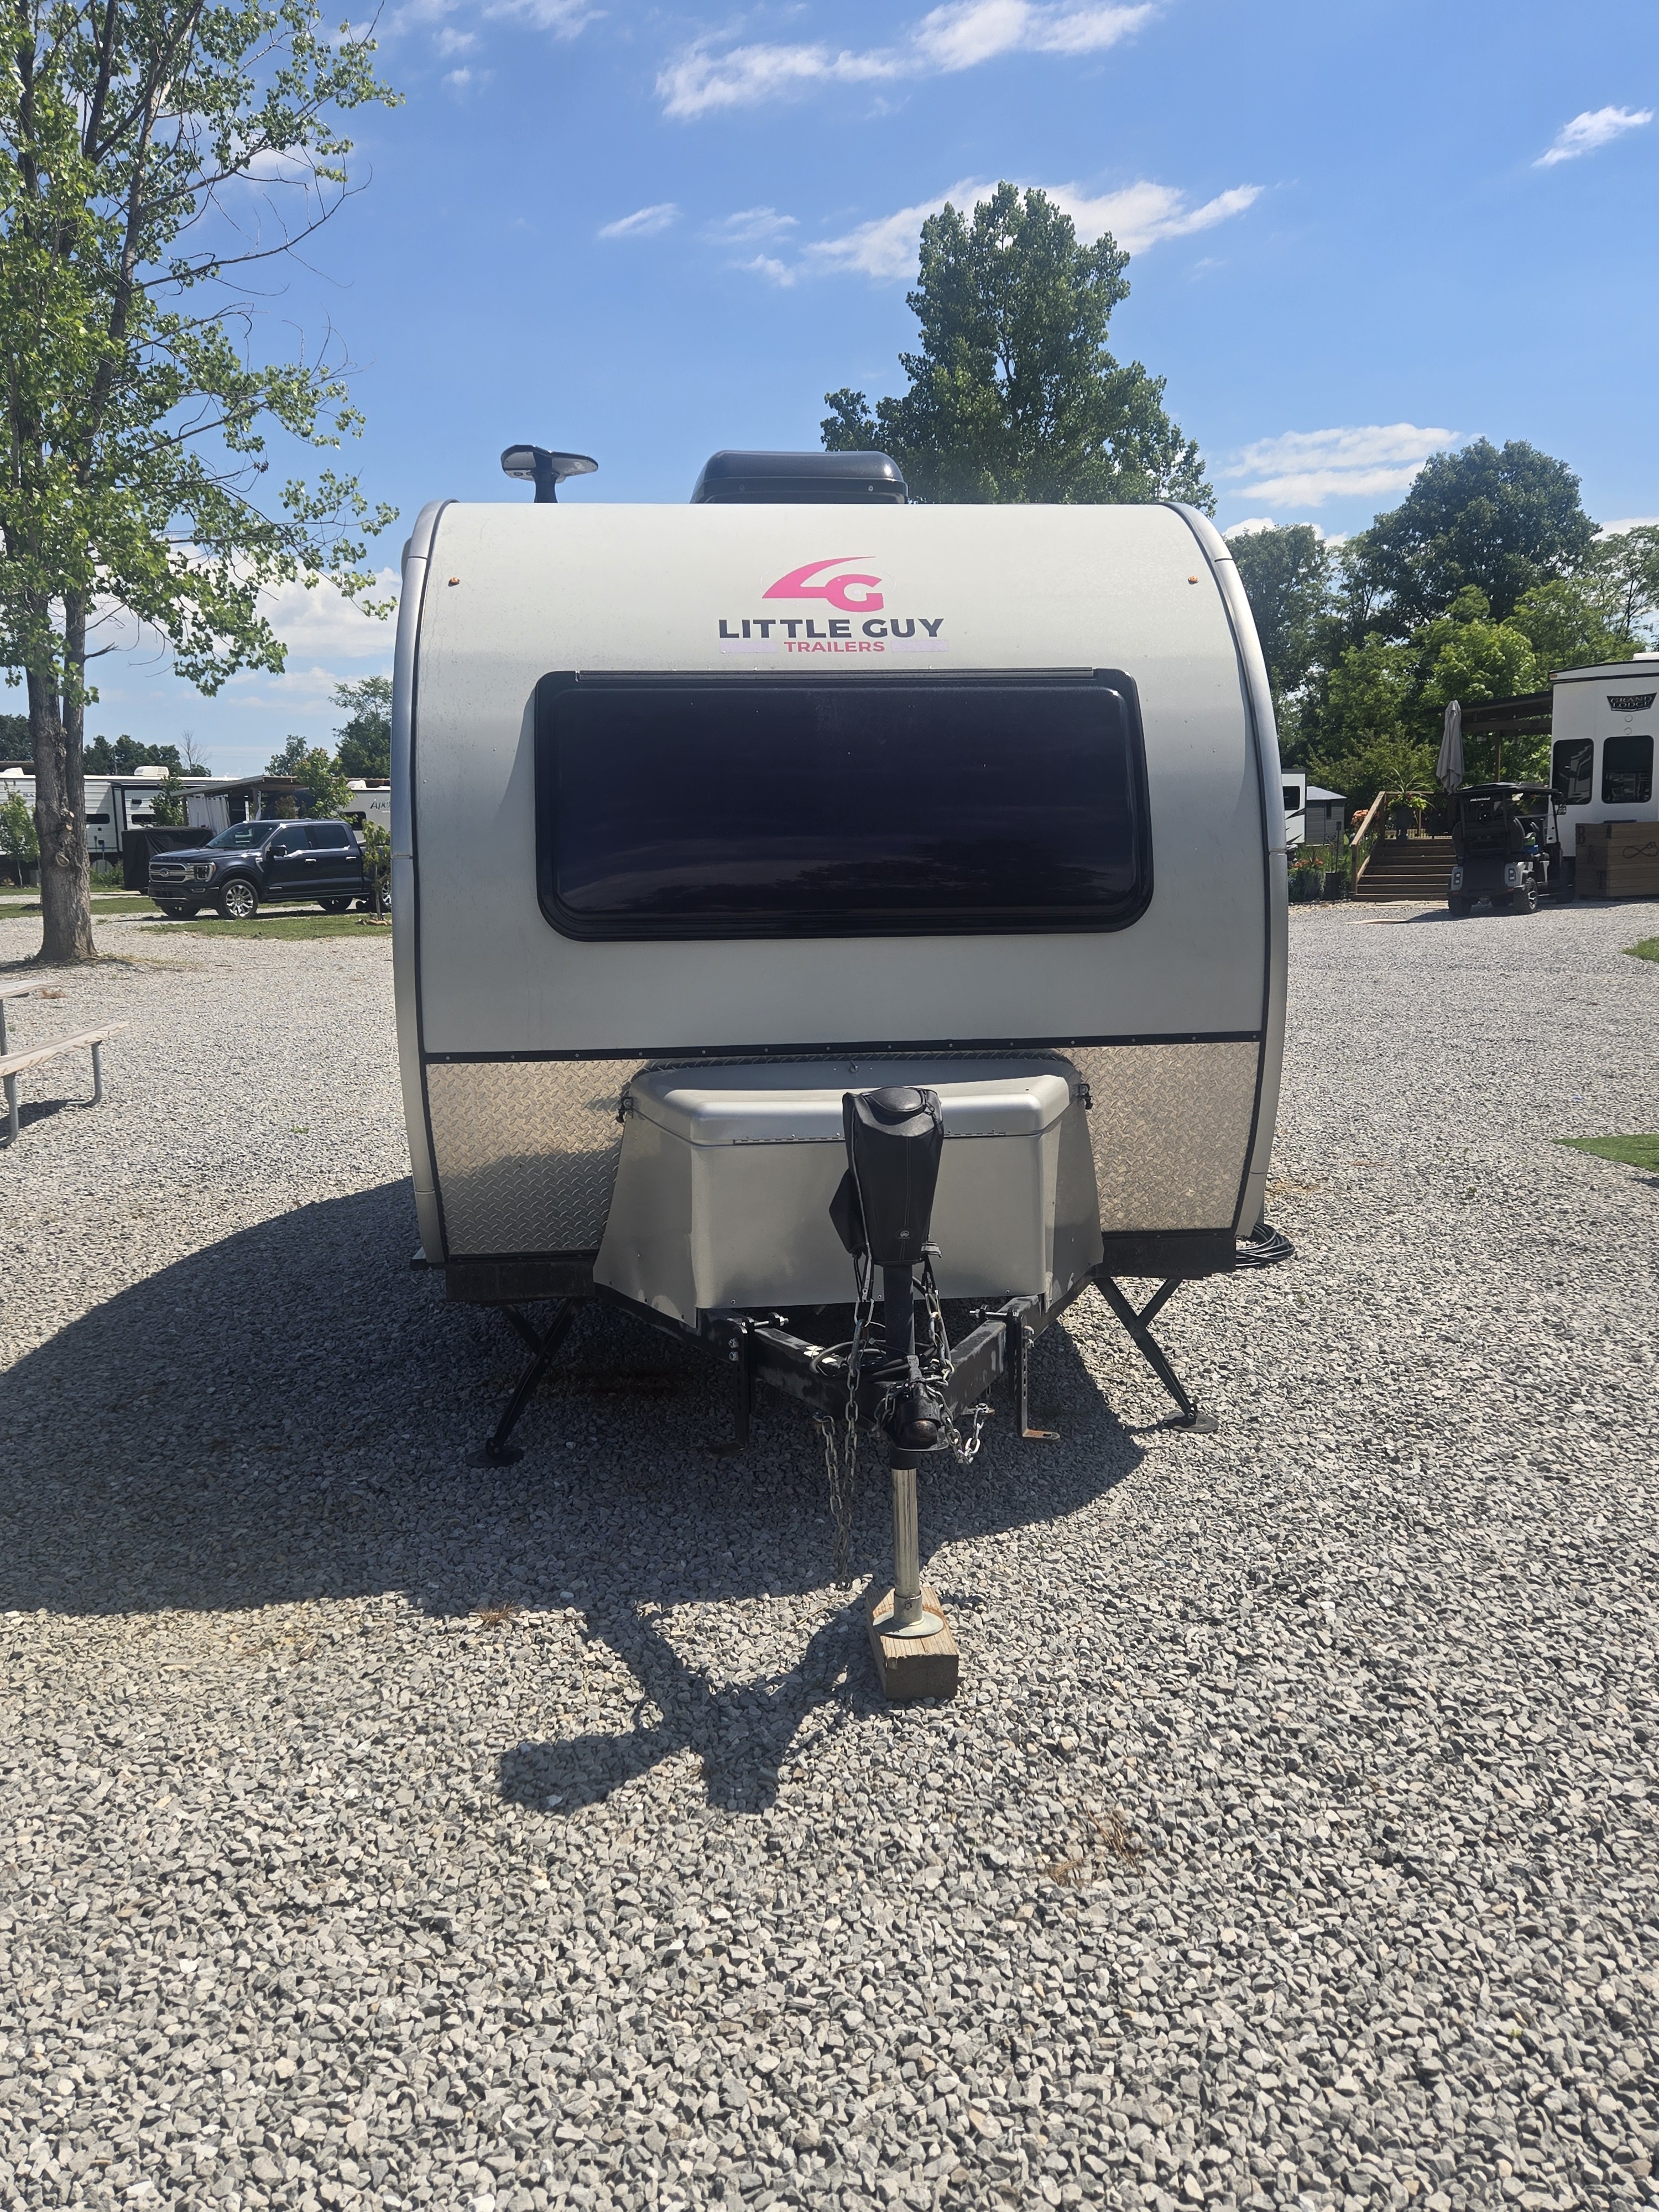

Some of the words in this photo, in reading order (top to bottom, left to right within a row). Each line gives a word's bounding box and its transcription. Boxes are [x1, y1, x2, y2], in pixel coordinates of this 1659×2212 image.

[719, 619, 852, 638] LITTLE
[862, 618, 944, 638] GUY
[784, 641, 885, 653] TRAILERS
